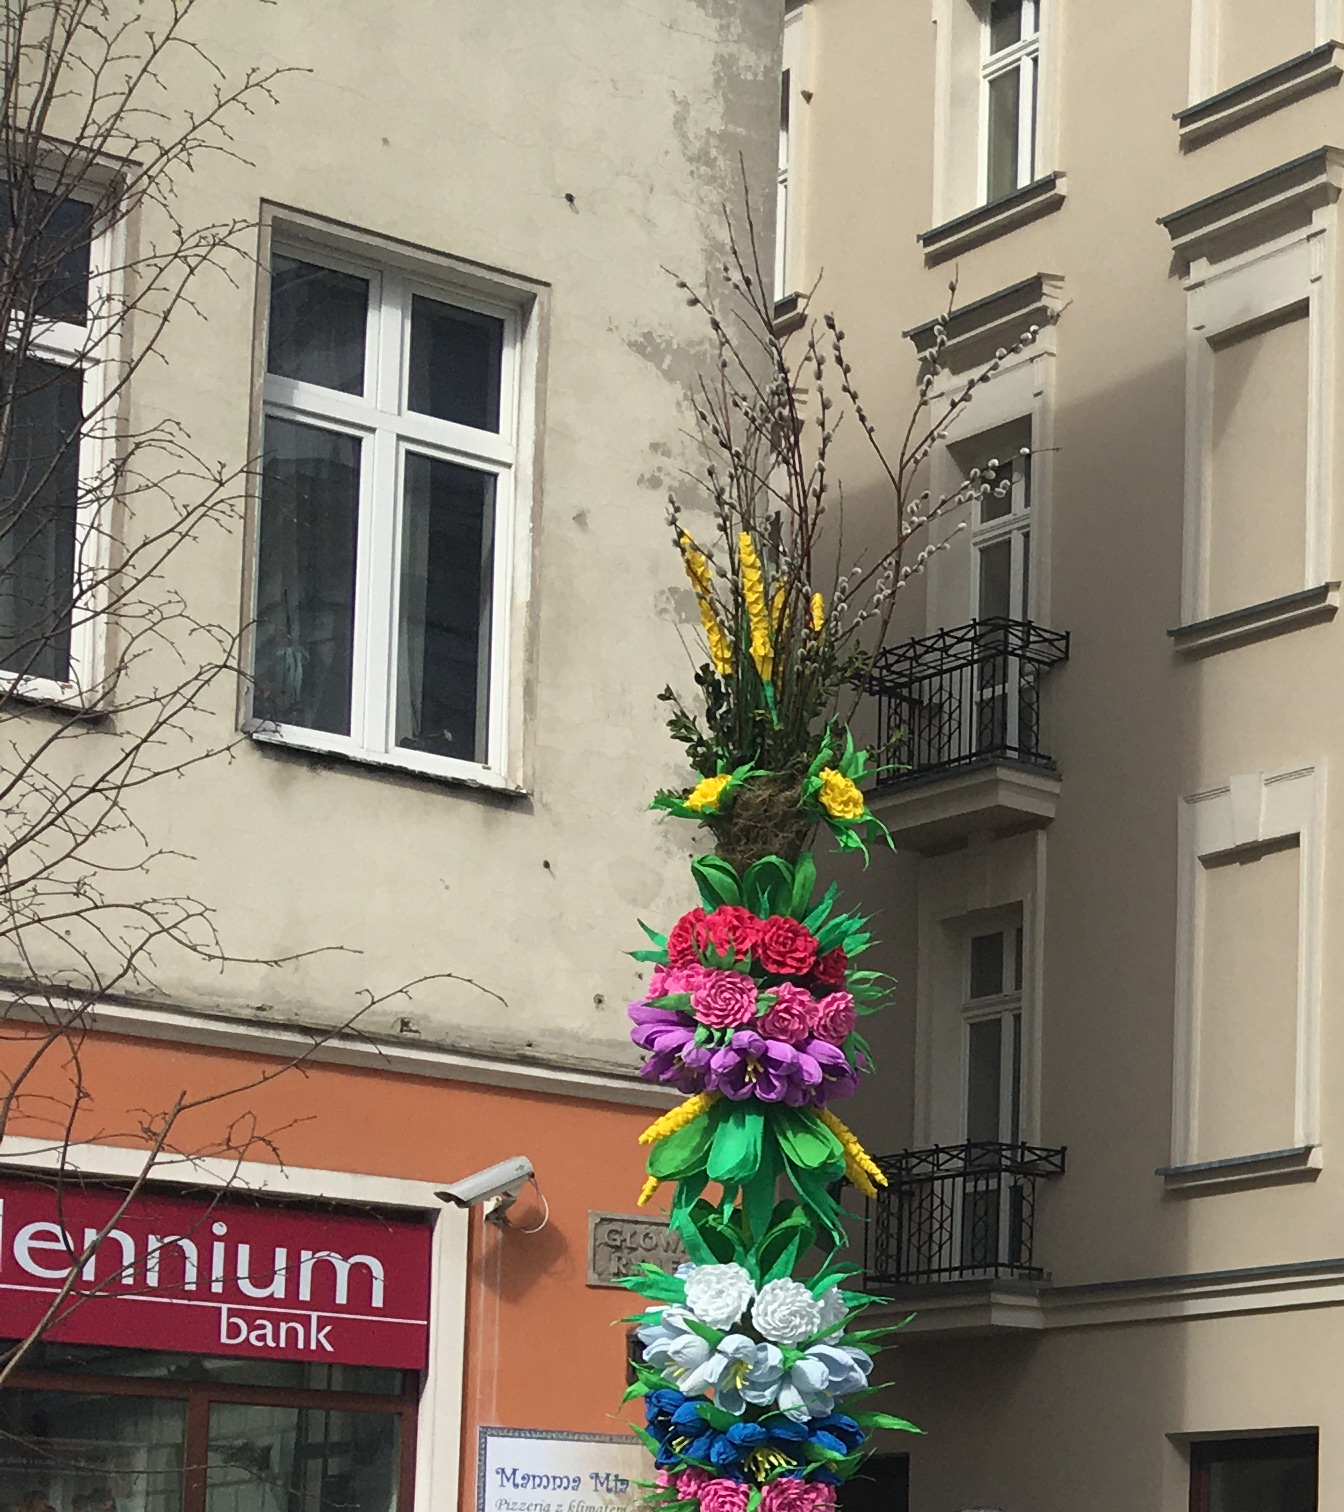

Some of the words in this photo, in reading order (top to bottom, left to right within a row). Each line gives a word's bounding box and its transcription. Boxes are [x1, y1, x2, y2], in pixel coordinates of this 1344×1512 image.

[0, 1198, 384, 1308] ennium
[220, 1305, 335, 1352] bank
[495, 1467, 582, 1491] Mamma
[589, 1472, 630, 1494] Mia
[495, 1498, 551, 1512] Pizzeria
